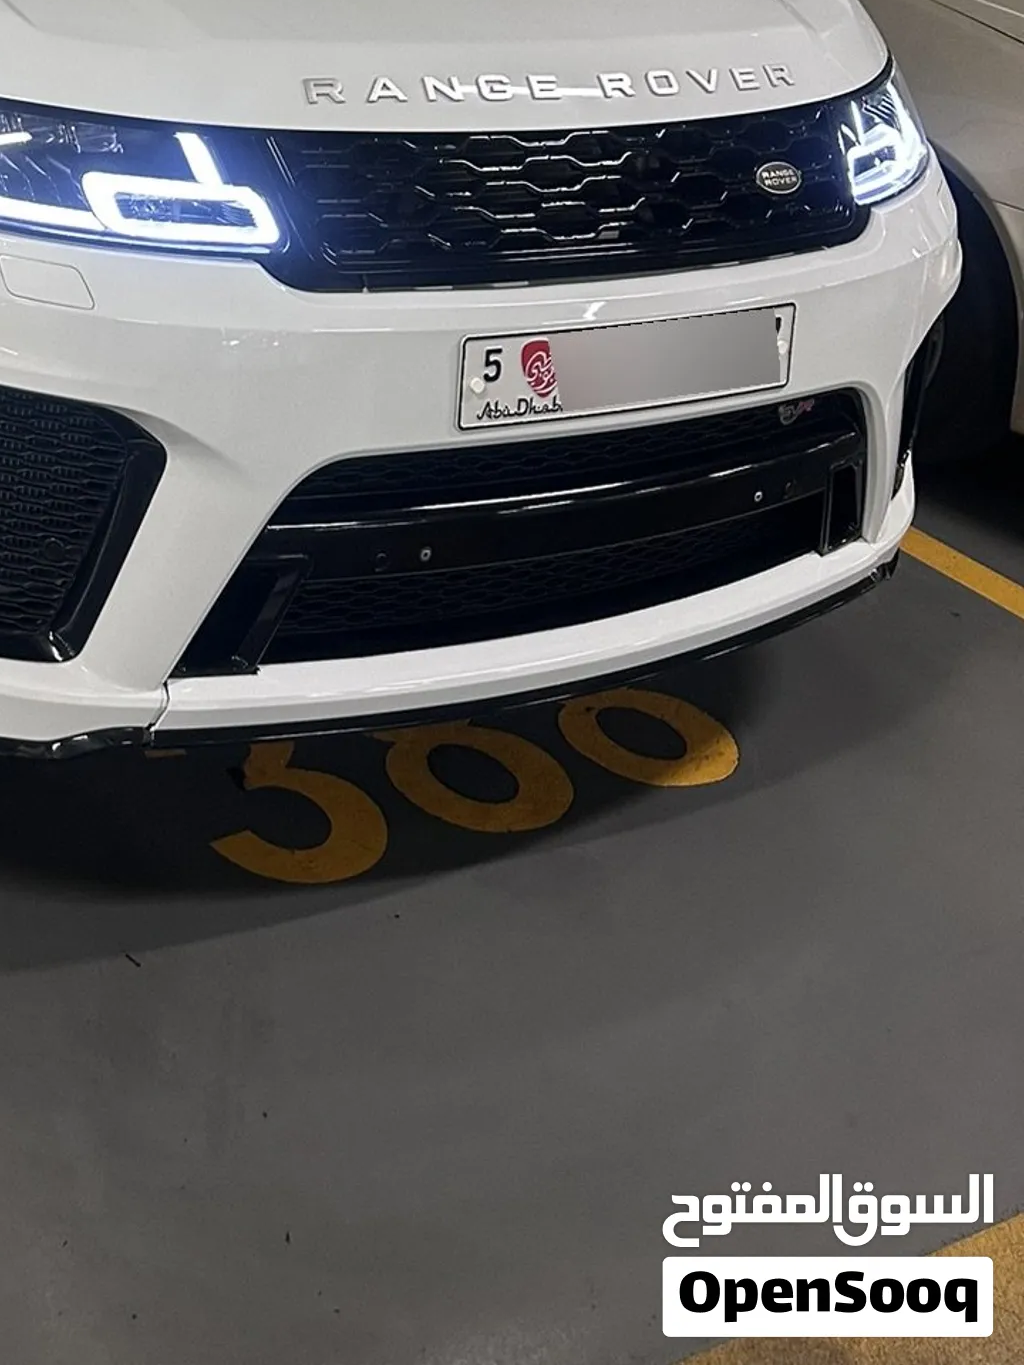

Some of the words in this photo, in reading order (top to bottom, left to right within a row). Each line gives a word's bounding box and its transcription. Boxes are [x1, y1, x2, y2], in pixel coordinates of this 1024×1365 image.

[302, 71, 563, 105] RANGE
[597, 62, 796, 100] ROVER
[761, 168, 795, 180] RANGE
[763, 176, 797, 187] ROVER
[483, 347, 503, 383] 5
[477, 400, 516, 421] Abu
